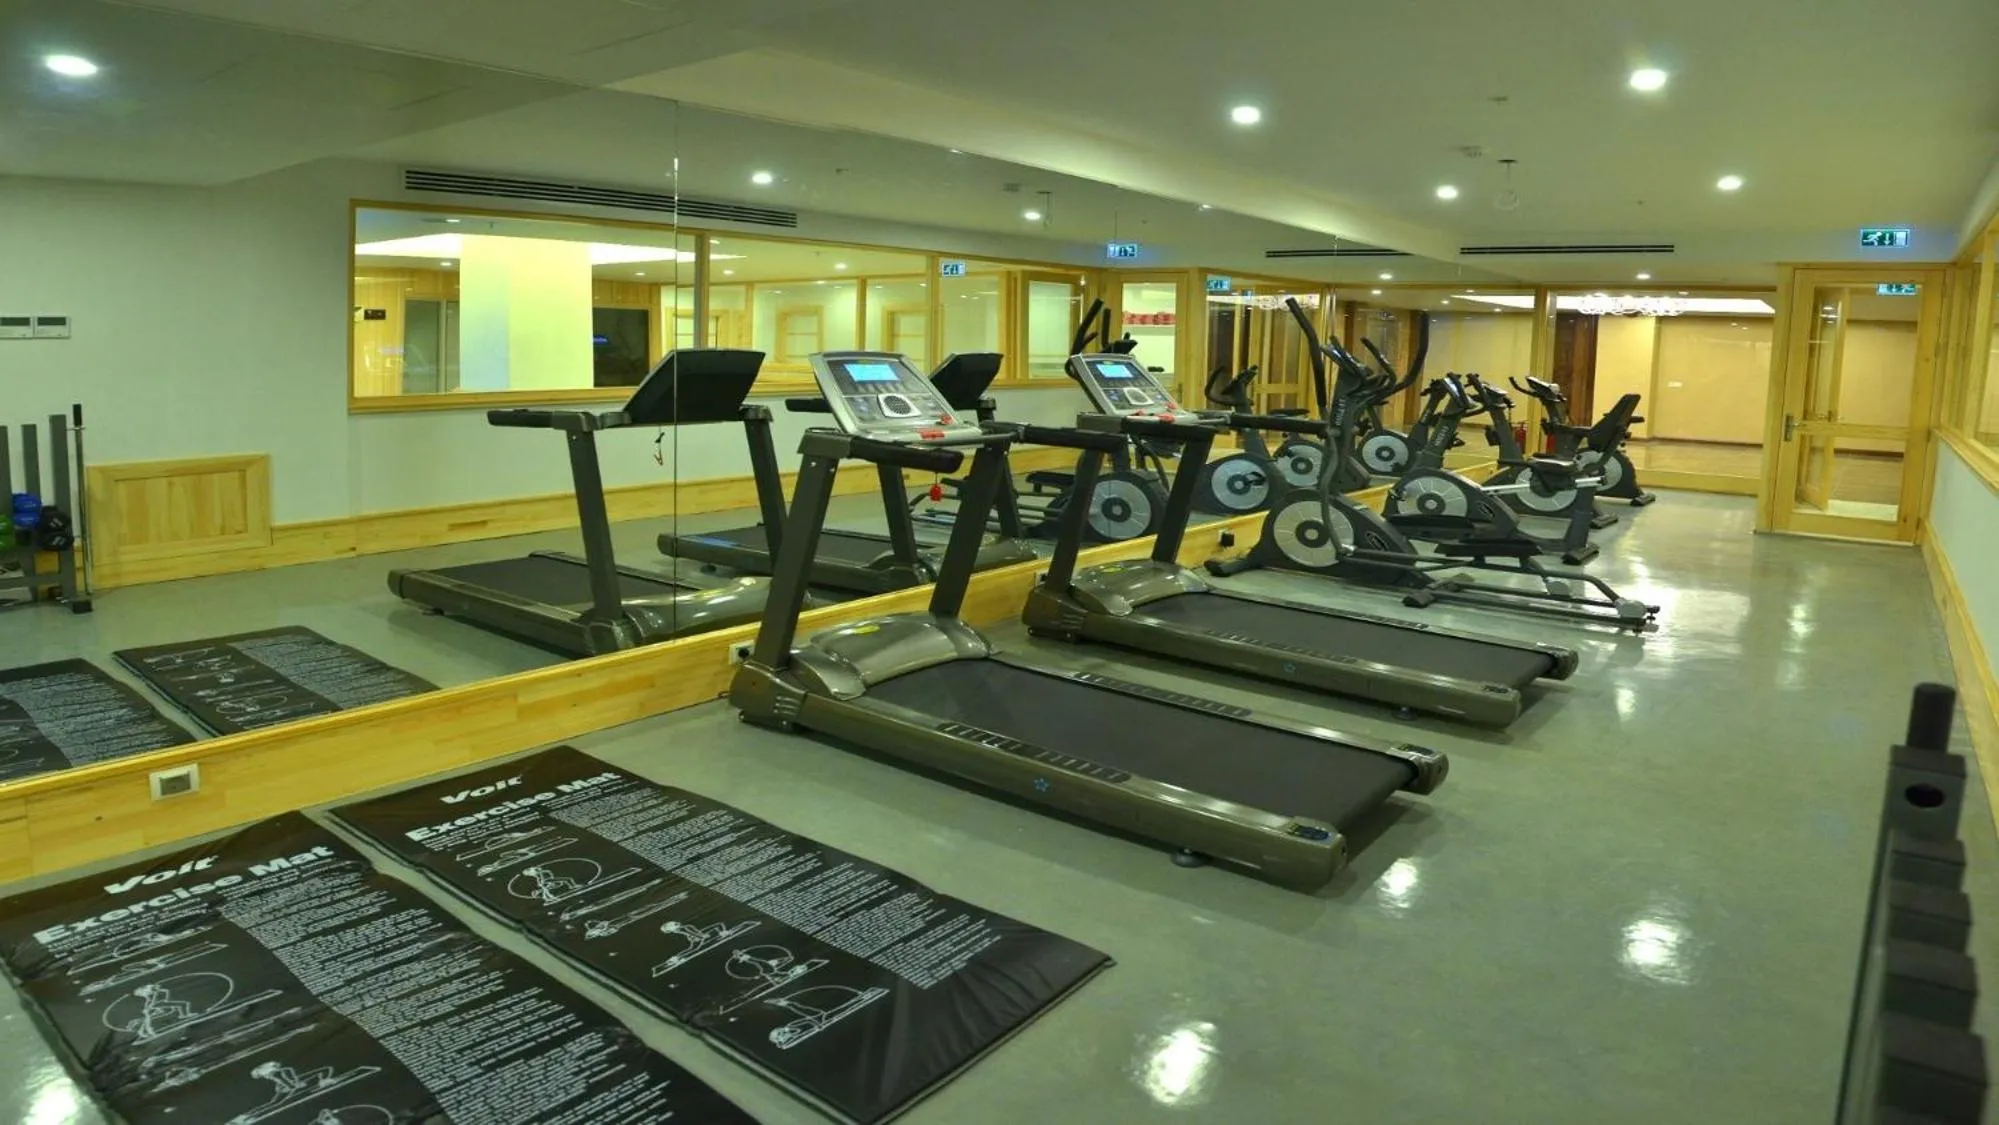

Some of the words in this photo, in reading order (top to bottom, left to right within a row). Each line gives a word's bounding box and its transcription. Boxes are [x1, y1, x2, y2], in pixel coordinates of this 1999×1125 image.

[405, 791, 556, 842] Exercise
[556, 772, 622, 793] Mat
[32, 874, 243, 945] Exercise
[248, 846, 335, 877] Mat
